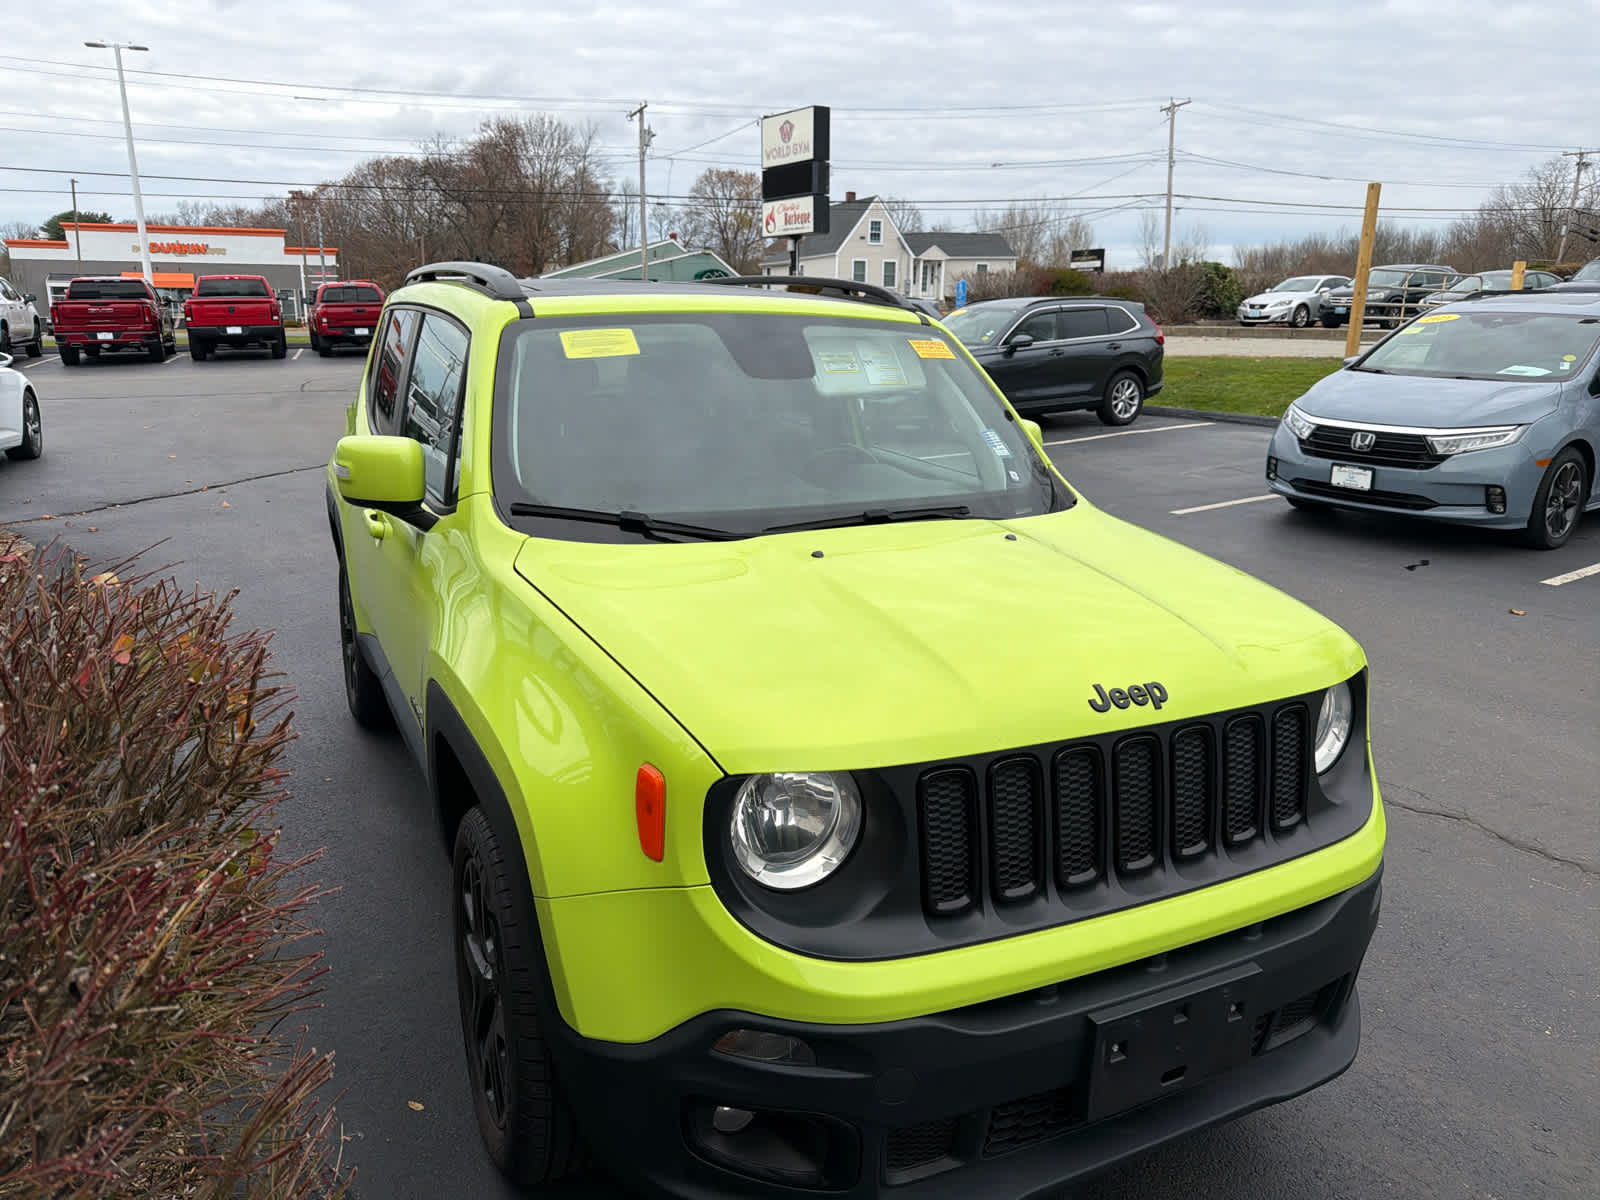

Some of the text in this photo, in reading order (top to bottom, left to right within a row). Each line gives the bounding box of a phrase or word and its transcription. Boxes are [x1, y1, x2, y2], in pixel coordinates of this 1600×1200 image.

[764, 143, 810, 160] WORLD GYM
[1088, 681, 1169, 713] Jeep
